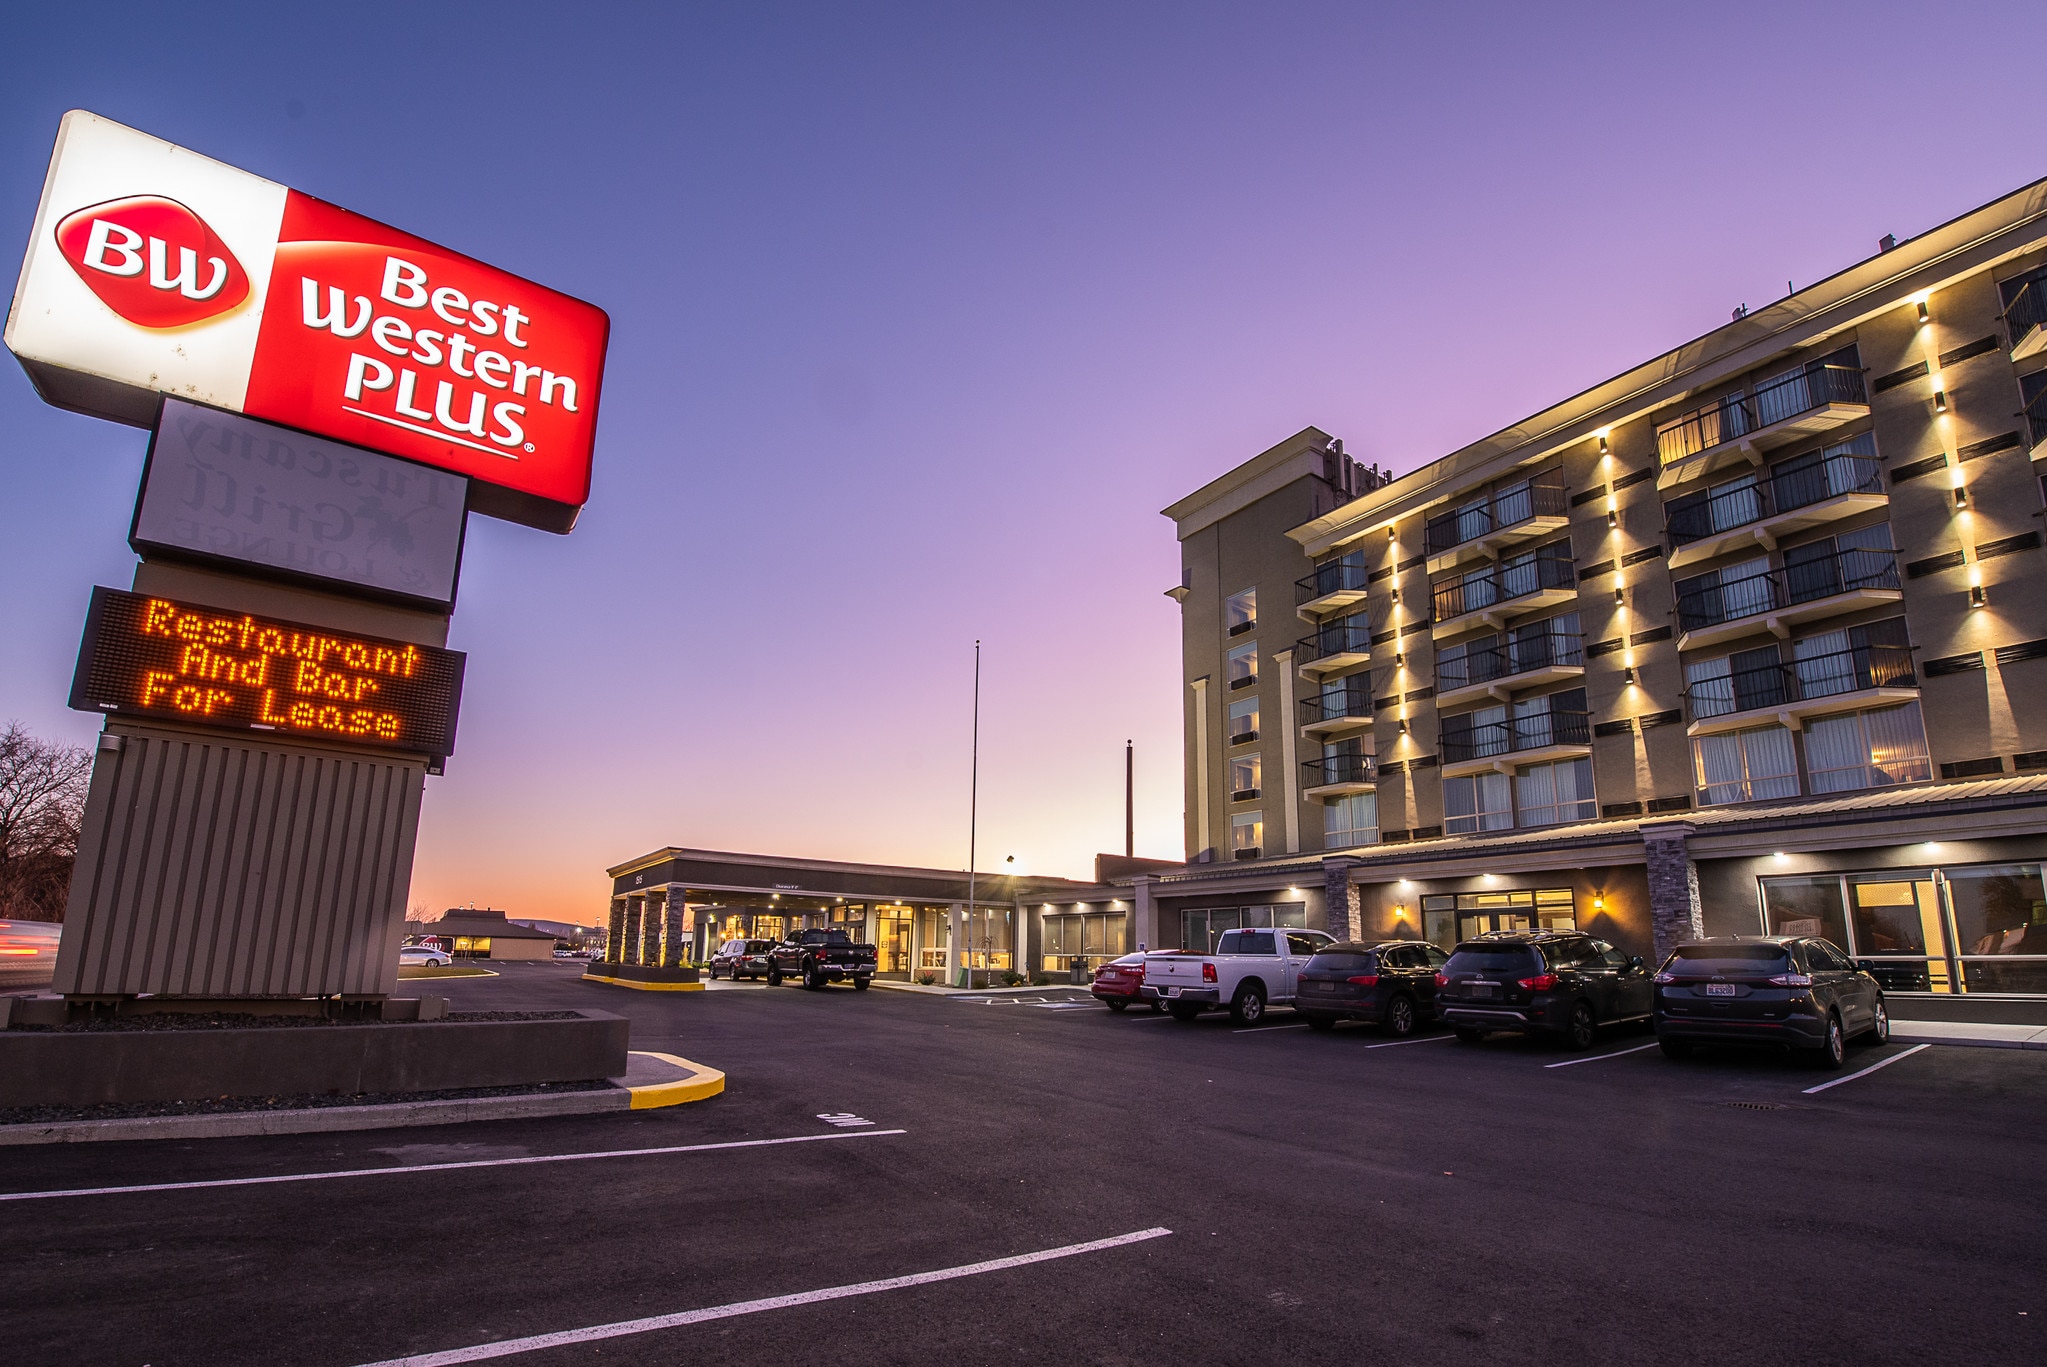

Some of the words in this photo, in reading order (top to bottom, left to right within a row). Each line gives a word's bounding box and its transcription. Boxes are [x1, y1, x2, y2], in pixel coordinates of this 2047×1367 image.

[82, 218, 228, 300] BW
[379, 256, 530, 349] Best
[301, 276, 579, 412] Western
[143, 599, 419, 678] Restaurant
[180, 642, 269, 686] And
[296, 660, 379, 701] Bar
[144, 670, 233, 715] For
[261, 688, 399, 739] Lease
